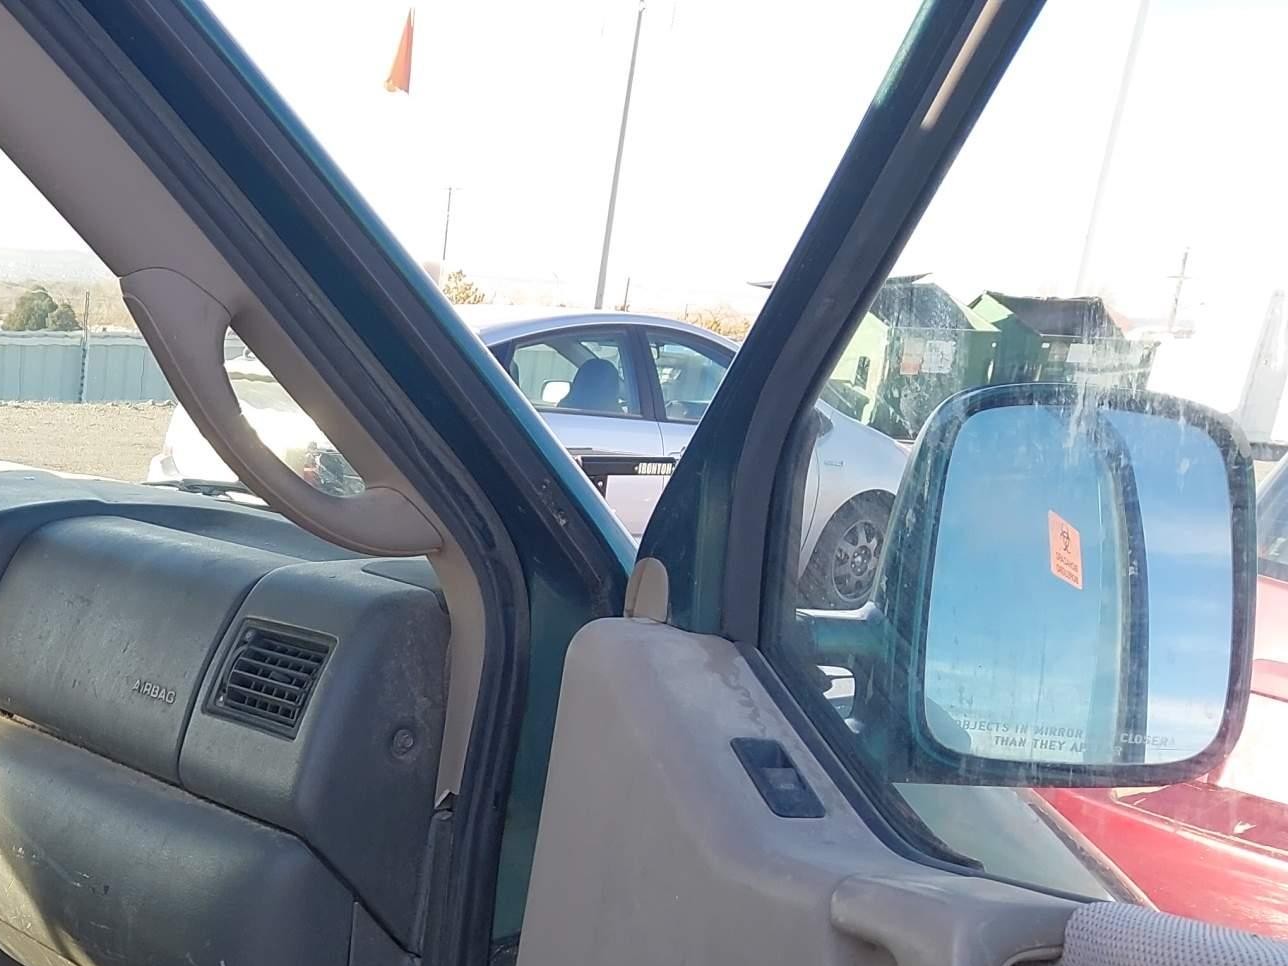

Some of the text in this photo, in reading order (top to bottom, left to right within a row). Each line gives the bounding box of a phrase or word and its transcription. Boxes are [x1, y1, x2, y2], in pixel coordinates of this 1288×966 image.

[131, 679, 177, 704] AIRBAG
[1015, 723, 1029, 734] IN
[1034, 725, 1084, 739] MIRROR
[994, 735, 1026, 747] THAN
[1032, 738, 1065, 751] THEY
